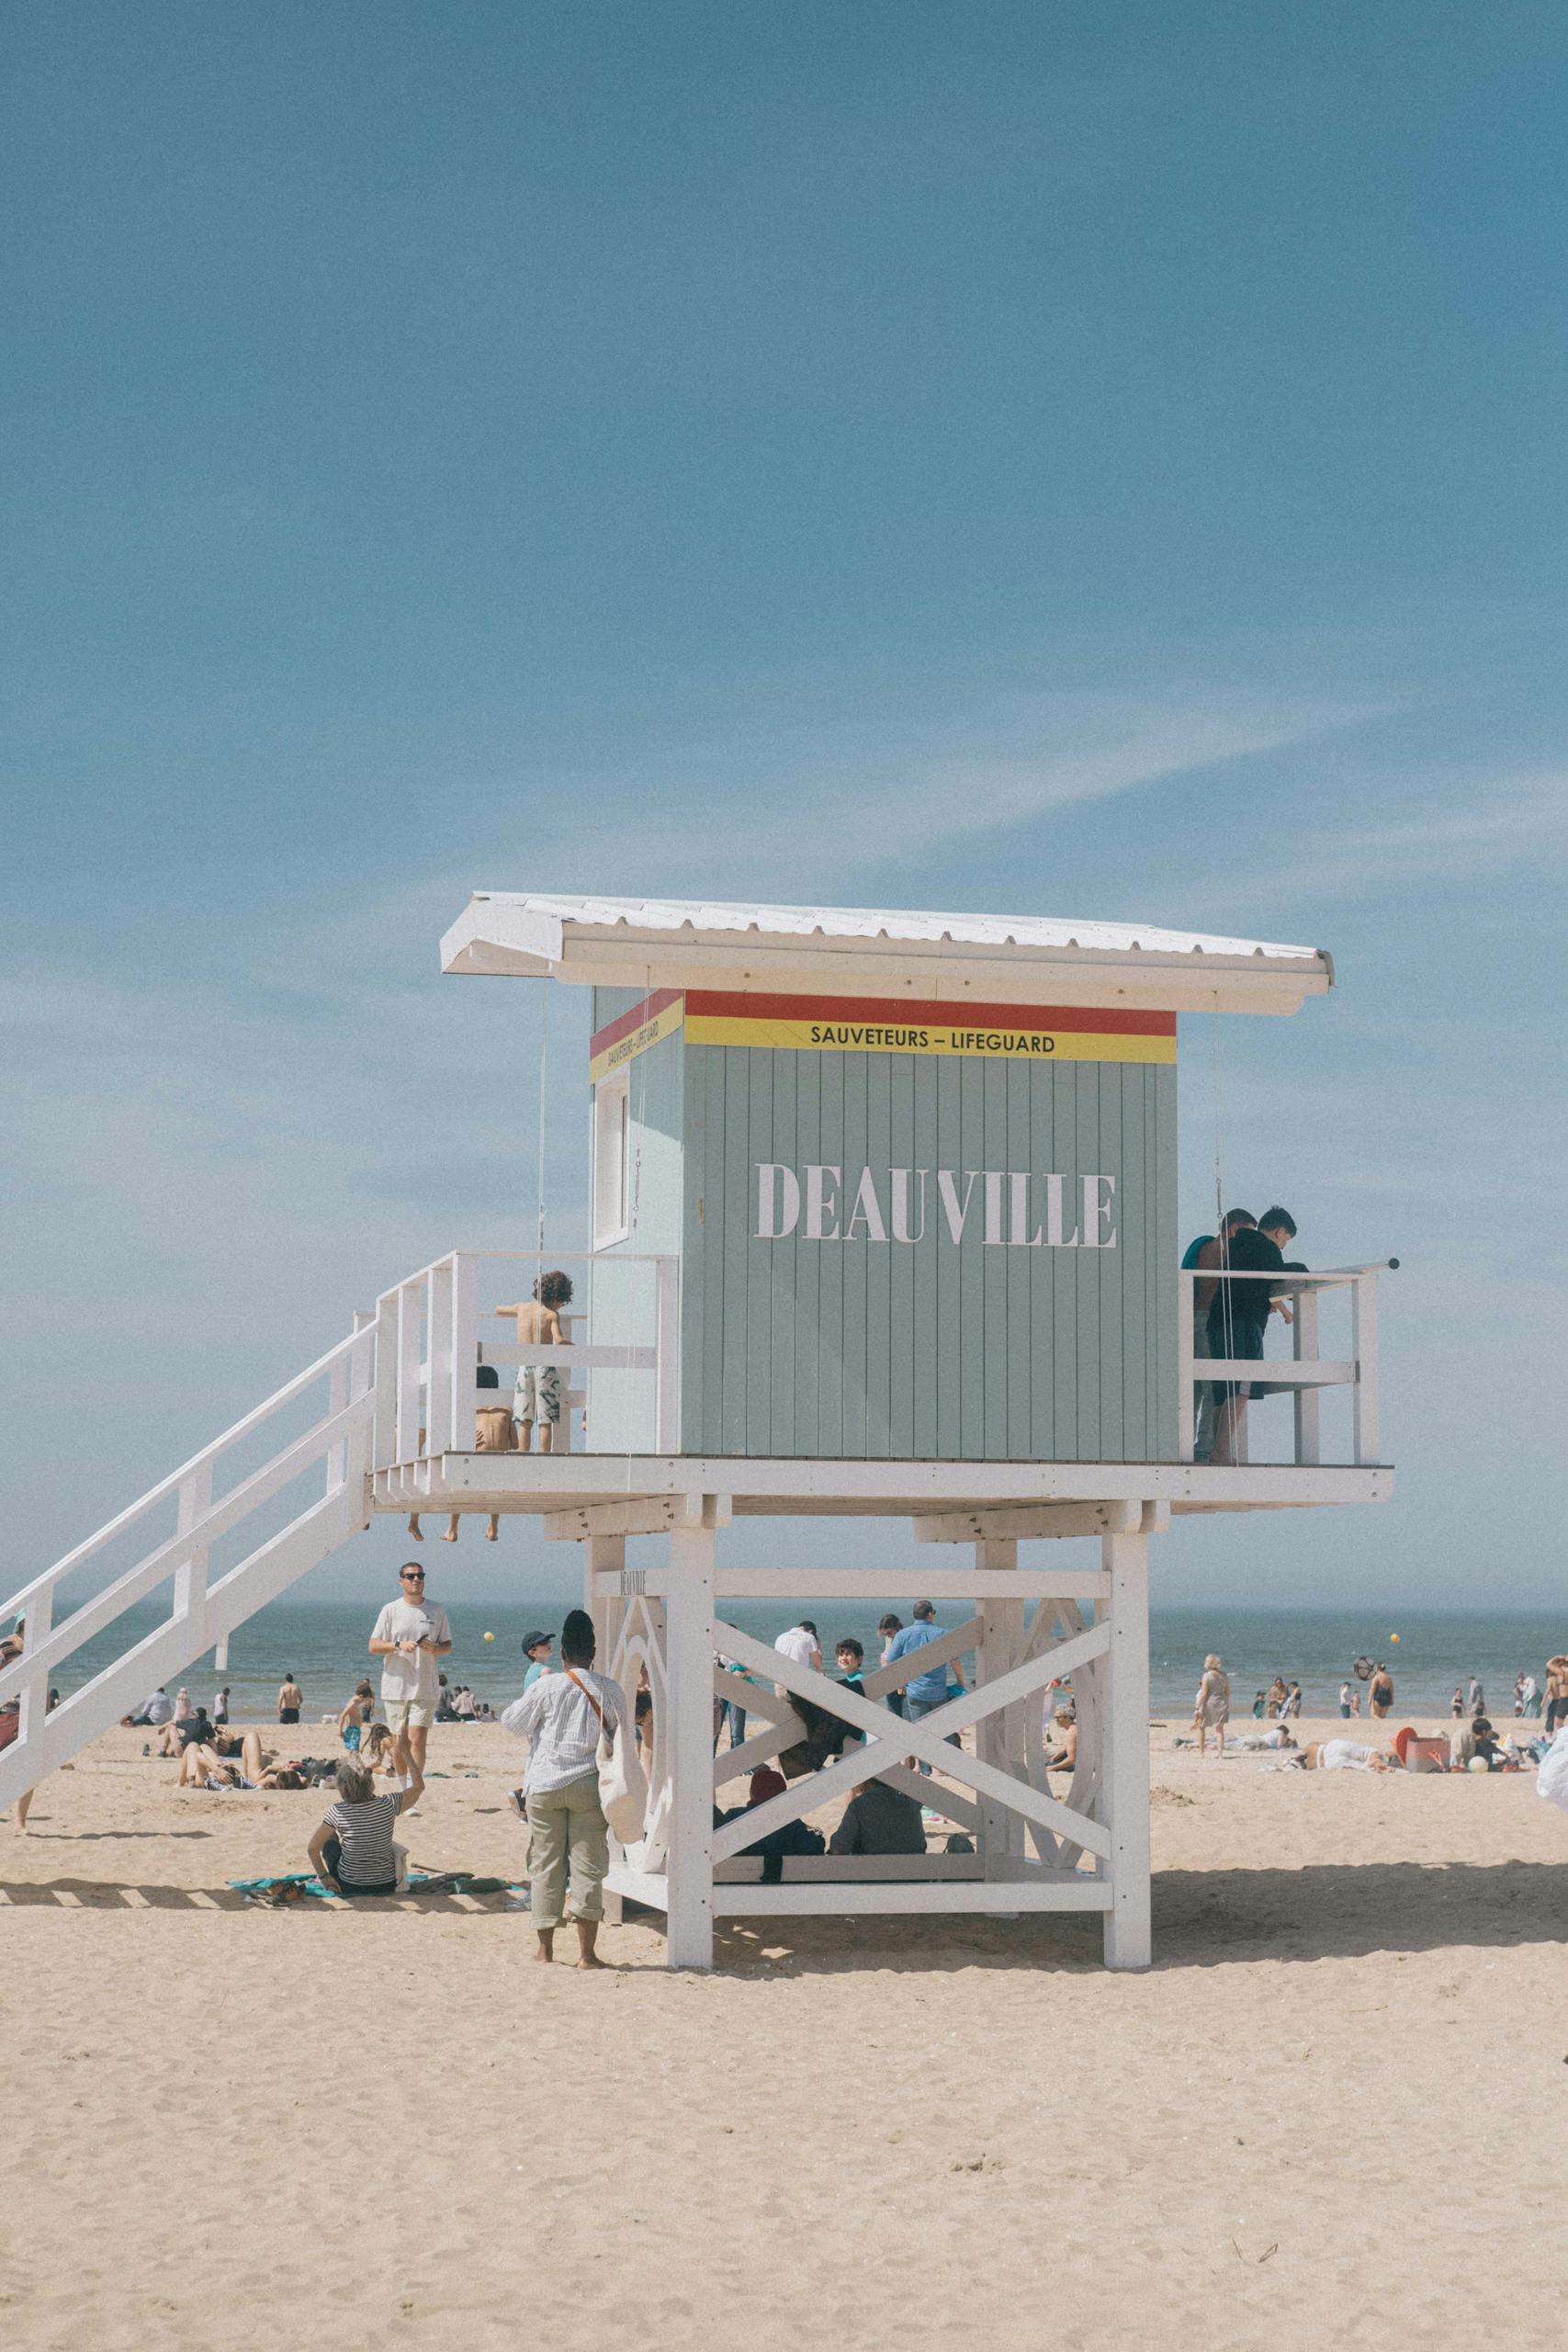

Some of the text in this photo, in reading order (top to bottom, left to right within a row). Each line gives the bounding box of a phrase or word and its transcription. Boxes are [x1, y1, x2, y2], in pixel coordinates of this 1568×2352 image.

[811, 1026, 929, 1047] SAUVETEURS
[952, 1032, 1055, 1053] LIFEGUARD
[753, 1163, 1117, 1249] DEAUVILLE
